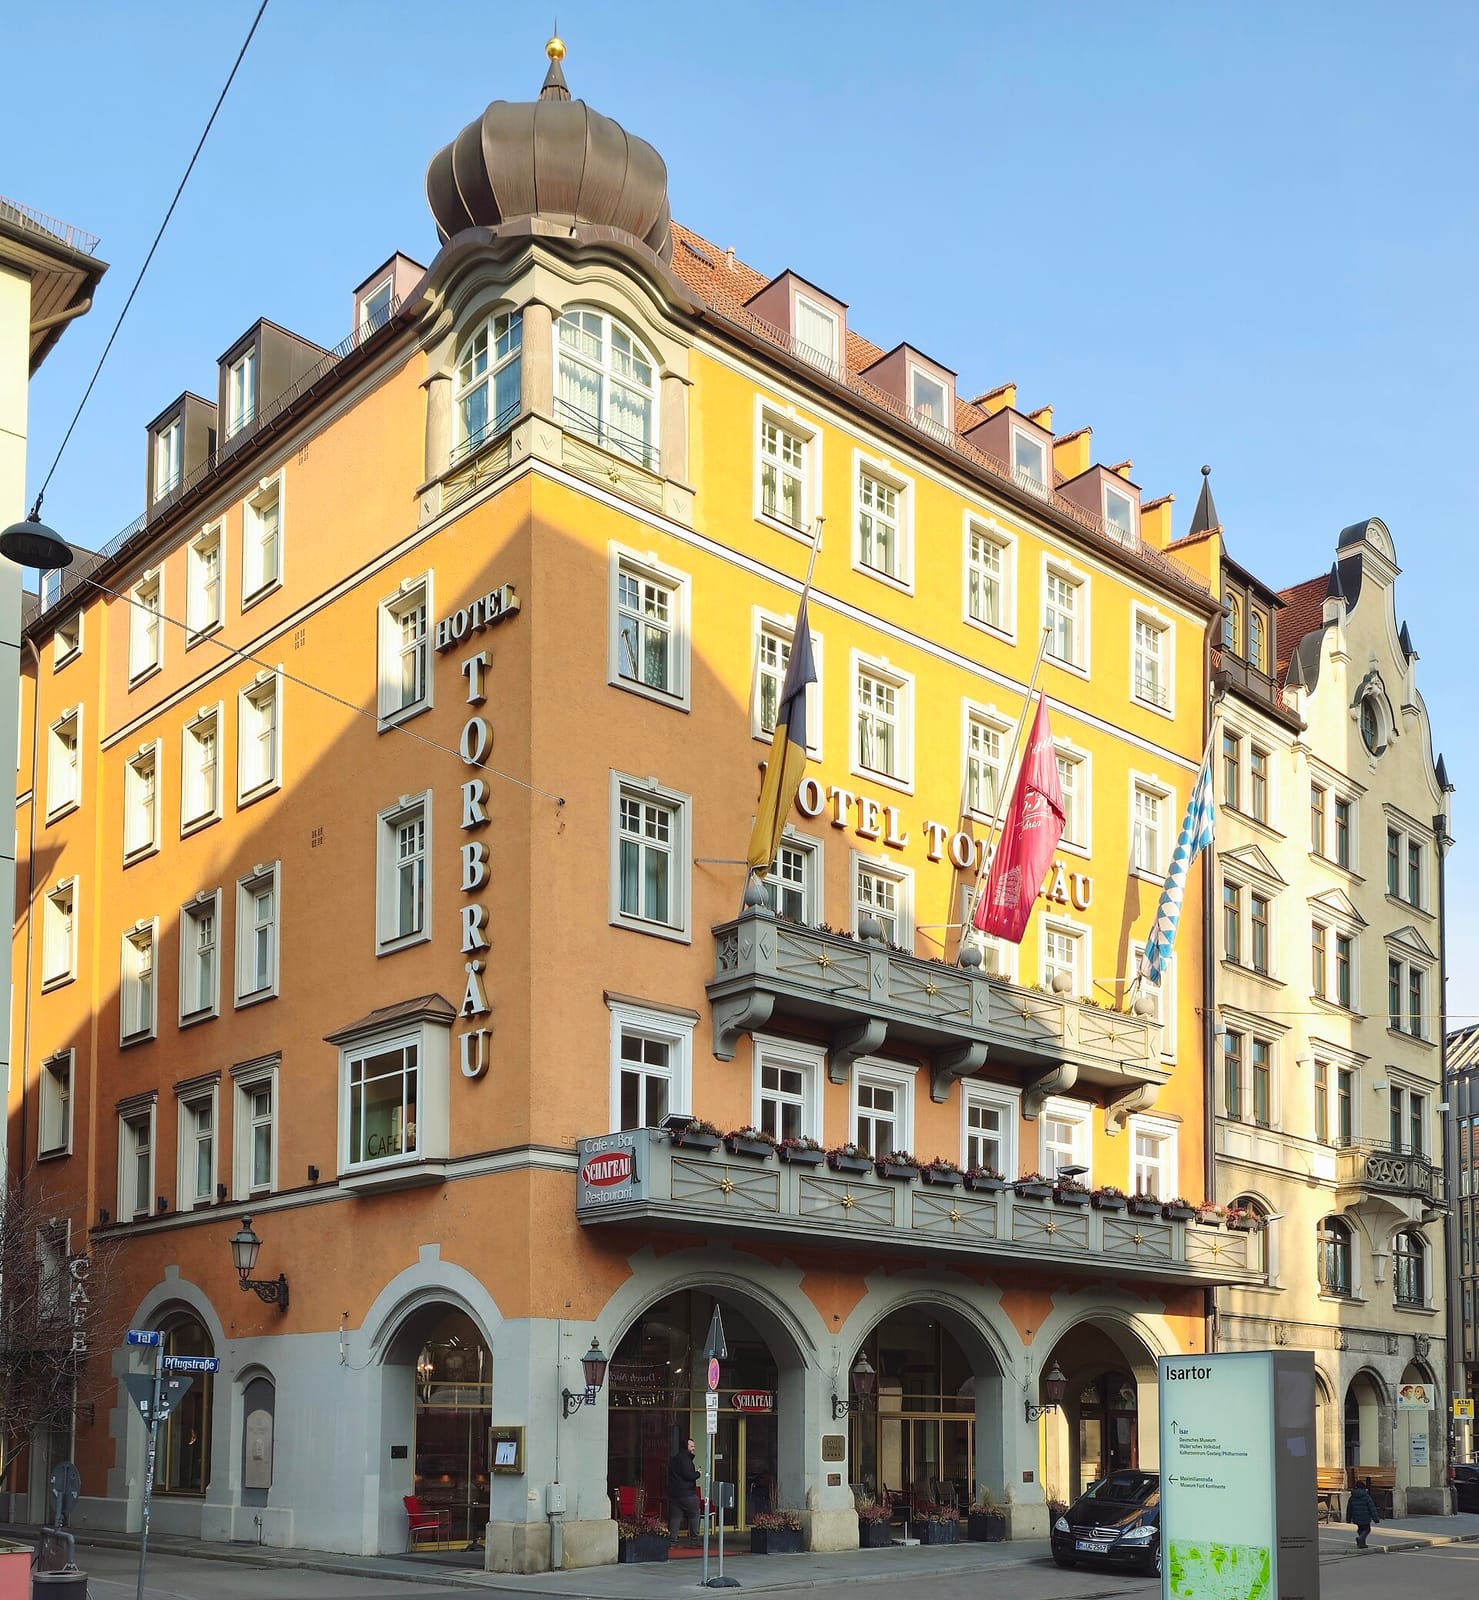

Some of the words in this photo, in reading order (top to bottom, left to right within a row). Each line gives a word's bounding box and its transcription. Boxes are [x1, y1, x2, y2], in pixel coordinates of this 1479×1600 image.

[434, 583, 519, 653] HOTEL
[758, 760, 908, 851] OTEL
[459, 651, 493, 1080] TORBRÄU
[617, 1133, 634, 1148] Bar
[585, 1185, 633, 1204] Restaurant
[136, 1333, 151, 1343] Tal
[165, 1357, 215, 1371] Pflugstraße
[1166, 1366, 1211, 1380] Isartor
